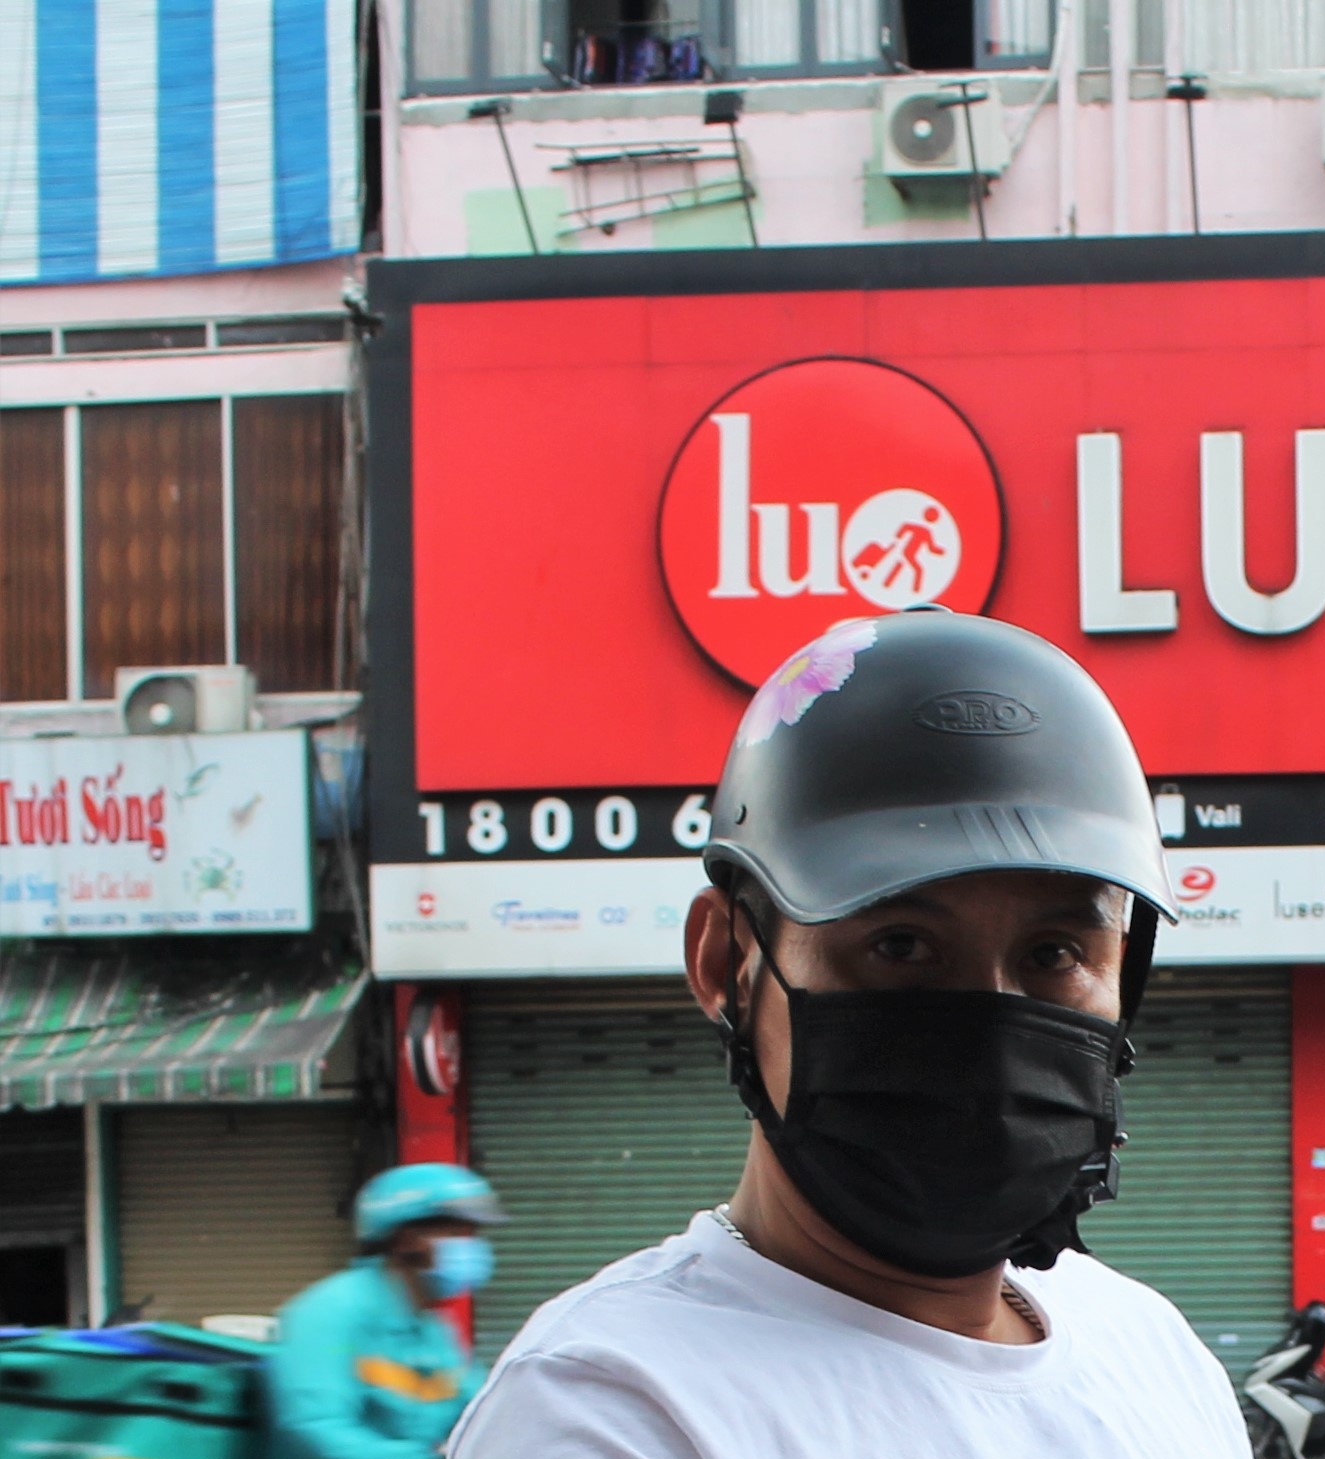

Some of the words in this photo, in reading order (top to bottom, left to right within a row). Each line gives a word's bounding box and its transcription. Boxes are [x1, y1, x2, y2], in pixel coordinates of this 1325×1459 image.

[81, 762, 167, 862] Sống
[418, 796, 638, 856] 1800
[1195, 804, 1242, 829] Vali
